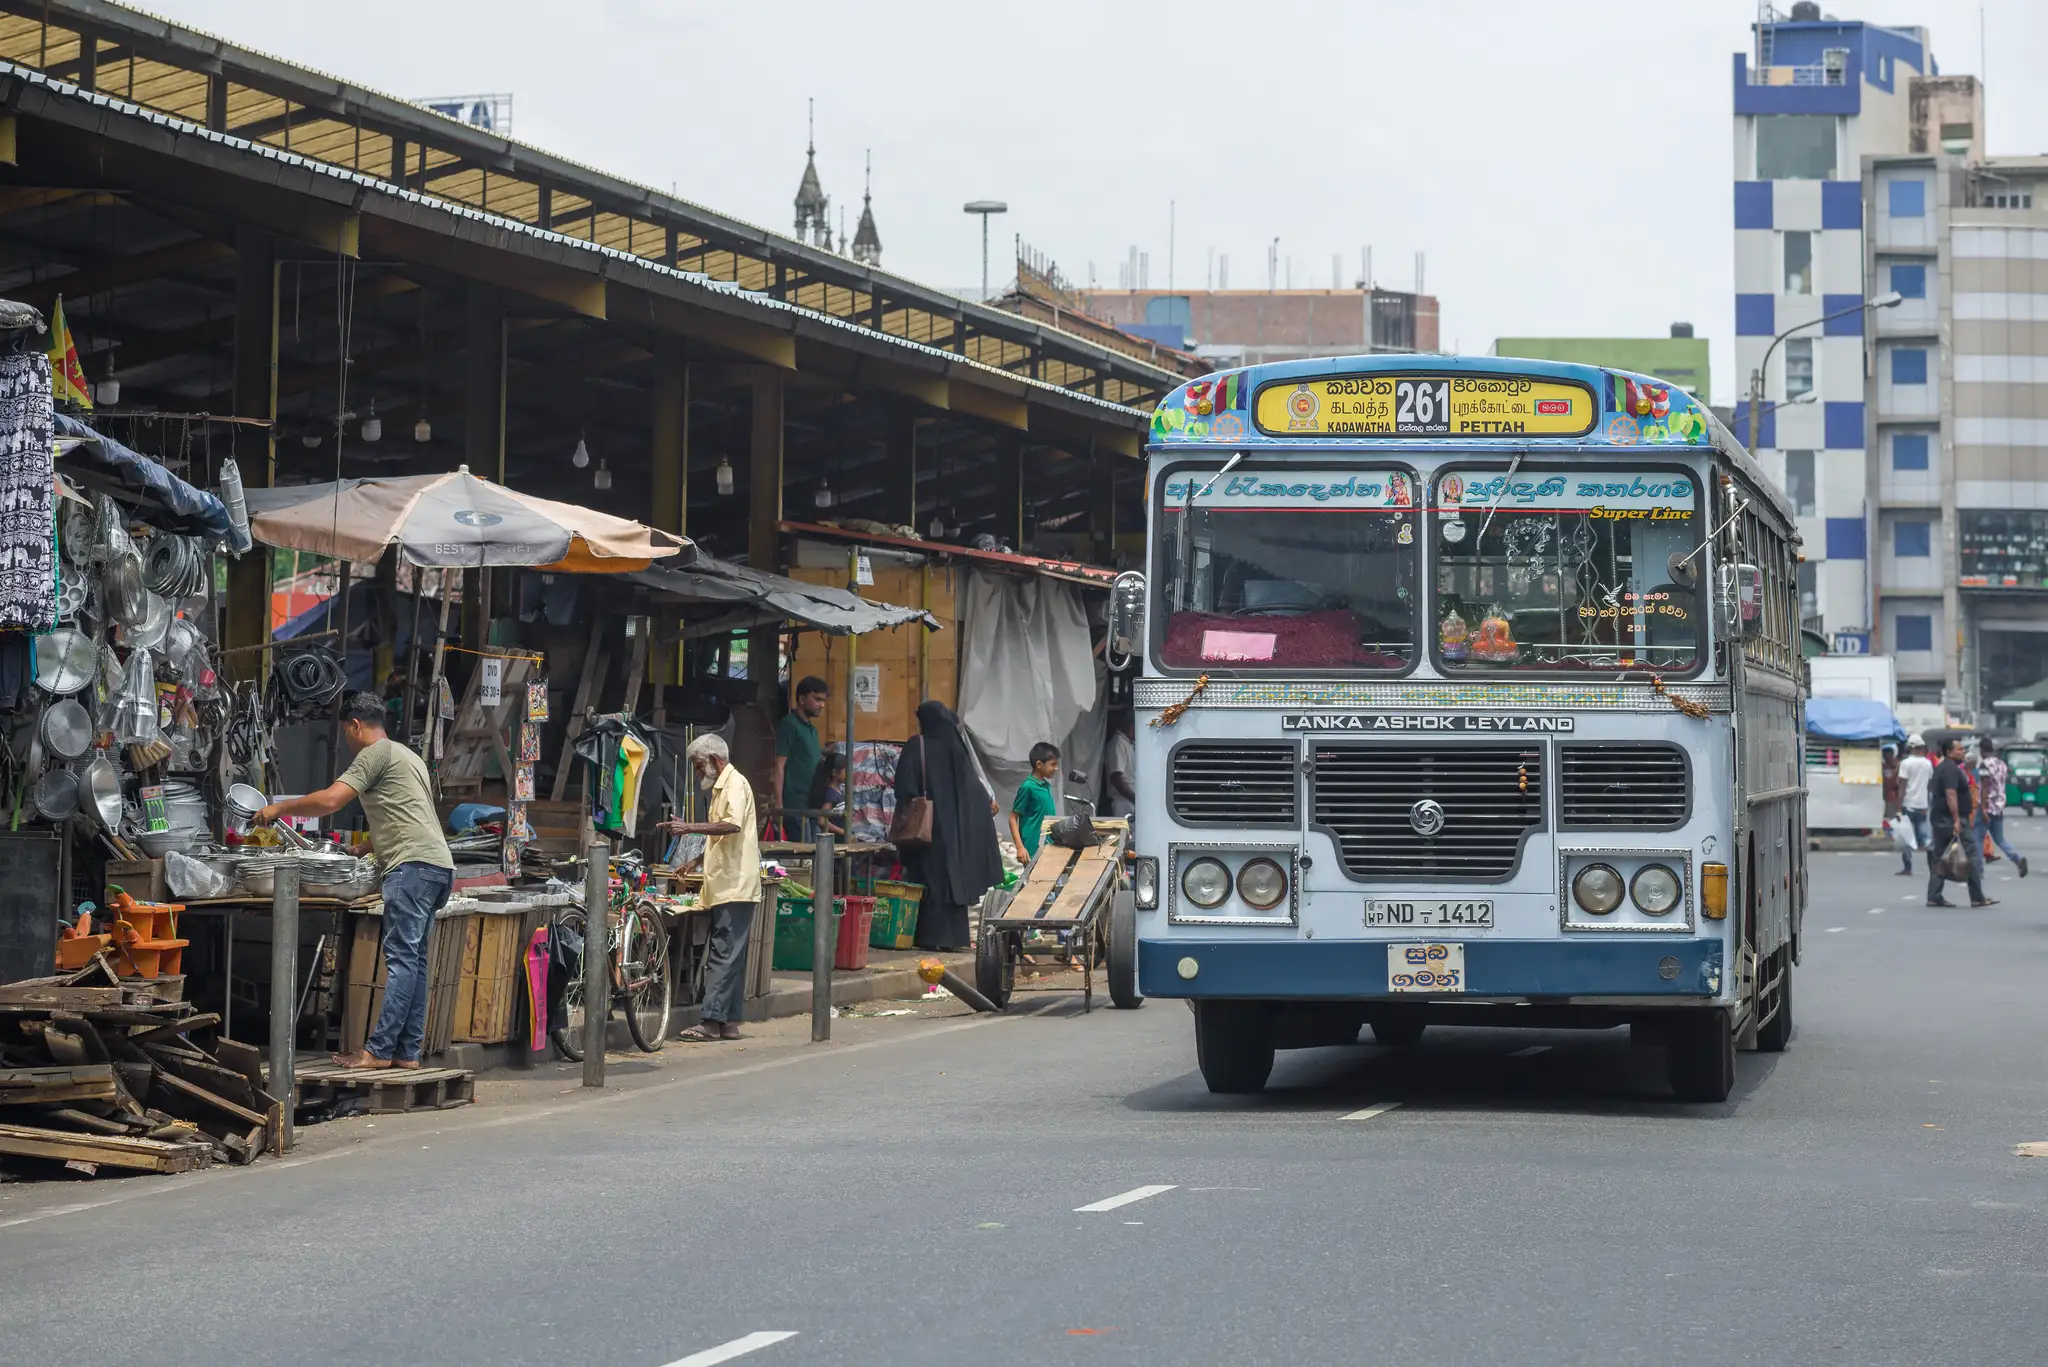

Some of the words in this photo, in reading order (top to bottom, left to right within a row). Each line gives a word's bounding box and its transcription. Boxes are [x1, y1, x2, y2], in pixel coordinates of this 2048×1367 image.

[1326, 380, 1392, 395] කඩවත
[1453, 379, 1532, 396] පිටකොටුව
[1330, 398, 1389, 419] கடவத்த
[1396, 382, 1449, 423] 261
[1453, 399, 1531, 417] புறக்கோட்டை
[1327, 422, 1391, 432] KADAWATHA
[1460, 421, 1525, 432] PETTAH
[1576, 477, 1693, 498] කතරගම
[1589, 506, 1649, 521] Super
[1649, 507, 1693, 520] Line
[435, 544, 466, 555] BEST
[487, 665, 498, 677] DVD
[481, 685, 489, 697] RS
[1283, 716, 1363, 729] LANKA
[1373, 716, 1456, 730] ASHOK
[1464, 717, 1573, 730] LEYLAND
[1368, 912, 1384, 923] WP
[1387, 903, 1414, 923] ND
[1438, 903, 1490, 923] 1412
[1405, 945, 1450, 965] සුබ
[1391, 969, 1460, 987] ගමන්
